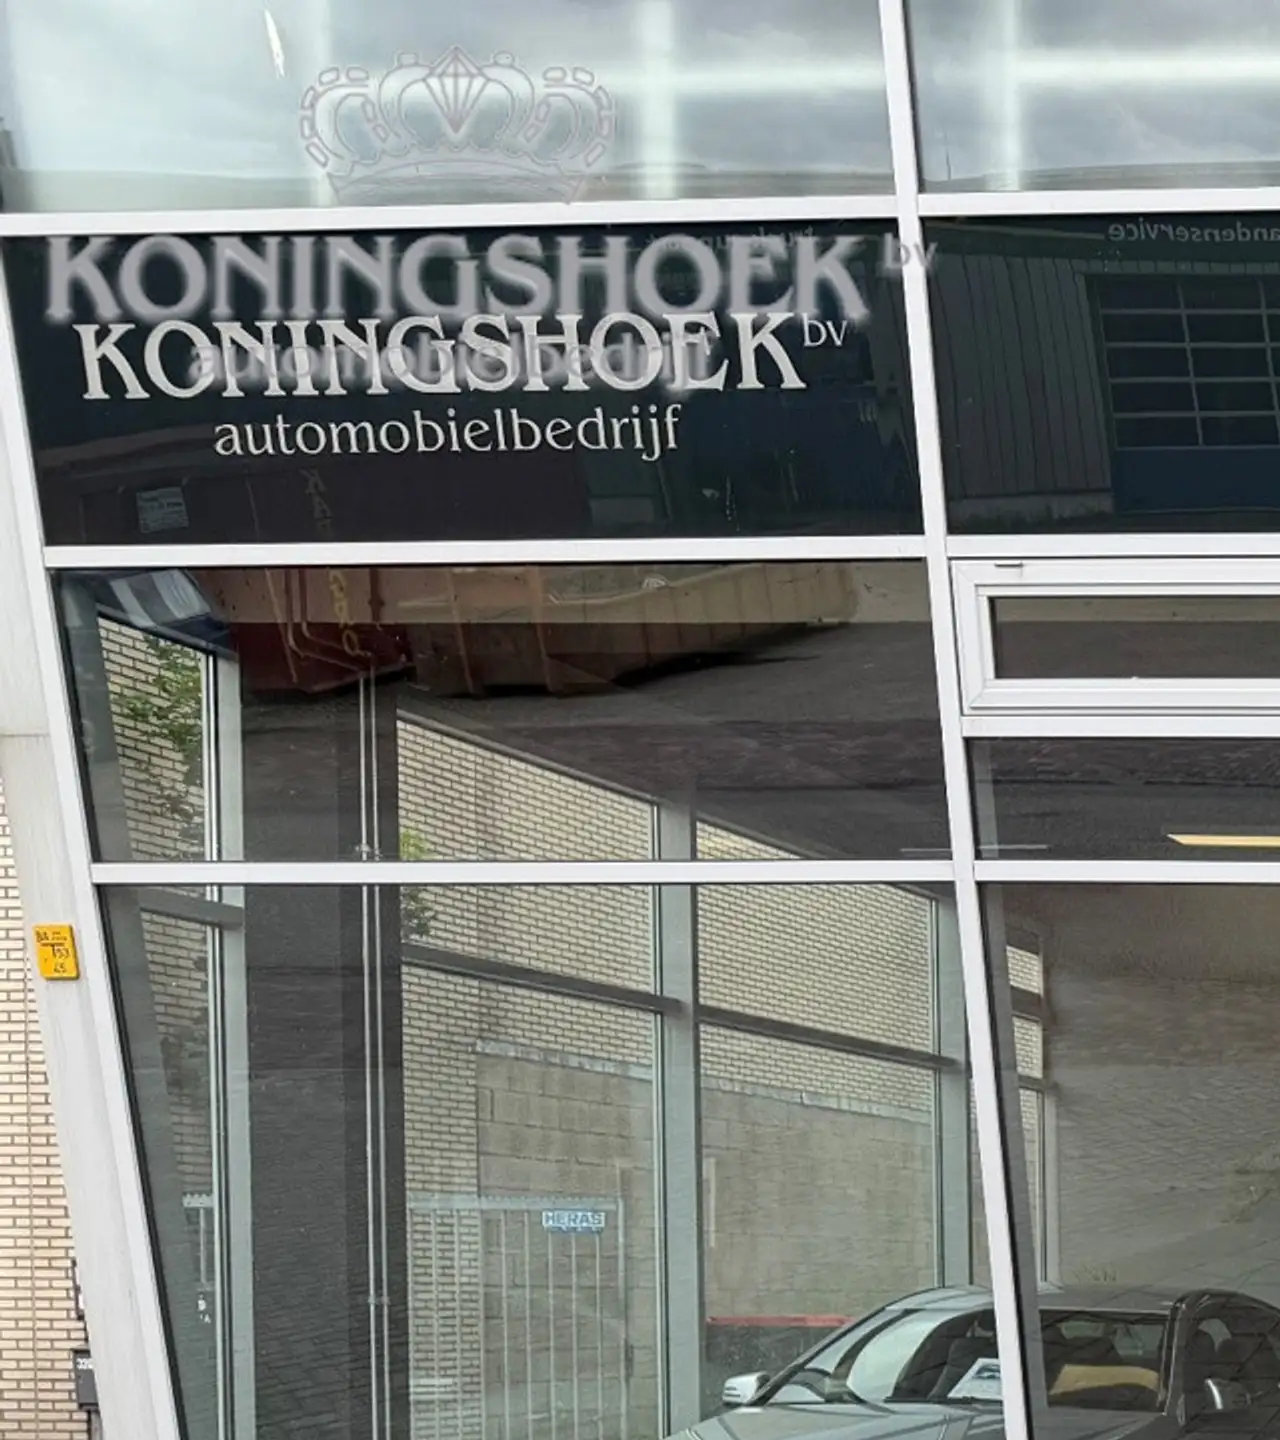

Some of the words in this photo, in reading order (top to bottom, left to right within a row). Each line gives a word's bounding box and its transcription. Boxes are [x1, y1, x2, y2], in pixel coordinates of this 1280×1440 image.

[74, 310, 806, 400] KONINGSHOEK
[802, 316, 849, 350] bv
[213, 403, 684, 463] automobielbedrijf
[541, 1210, 603, 1228] HERAS
